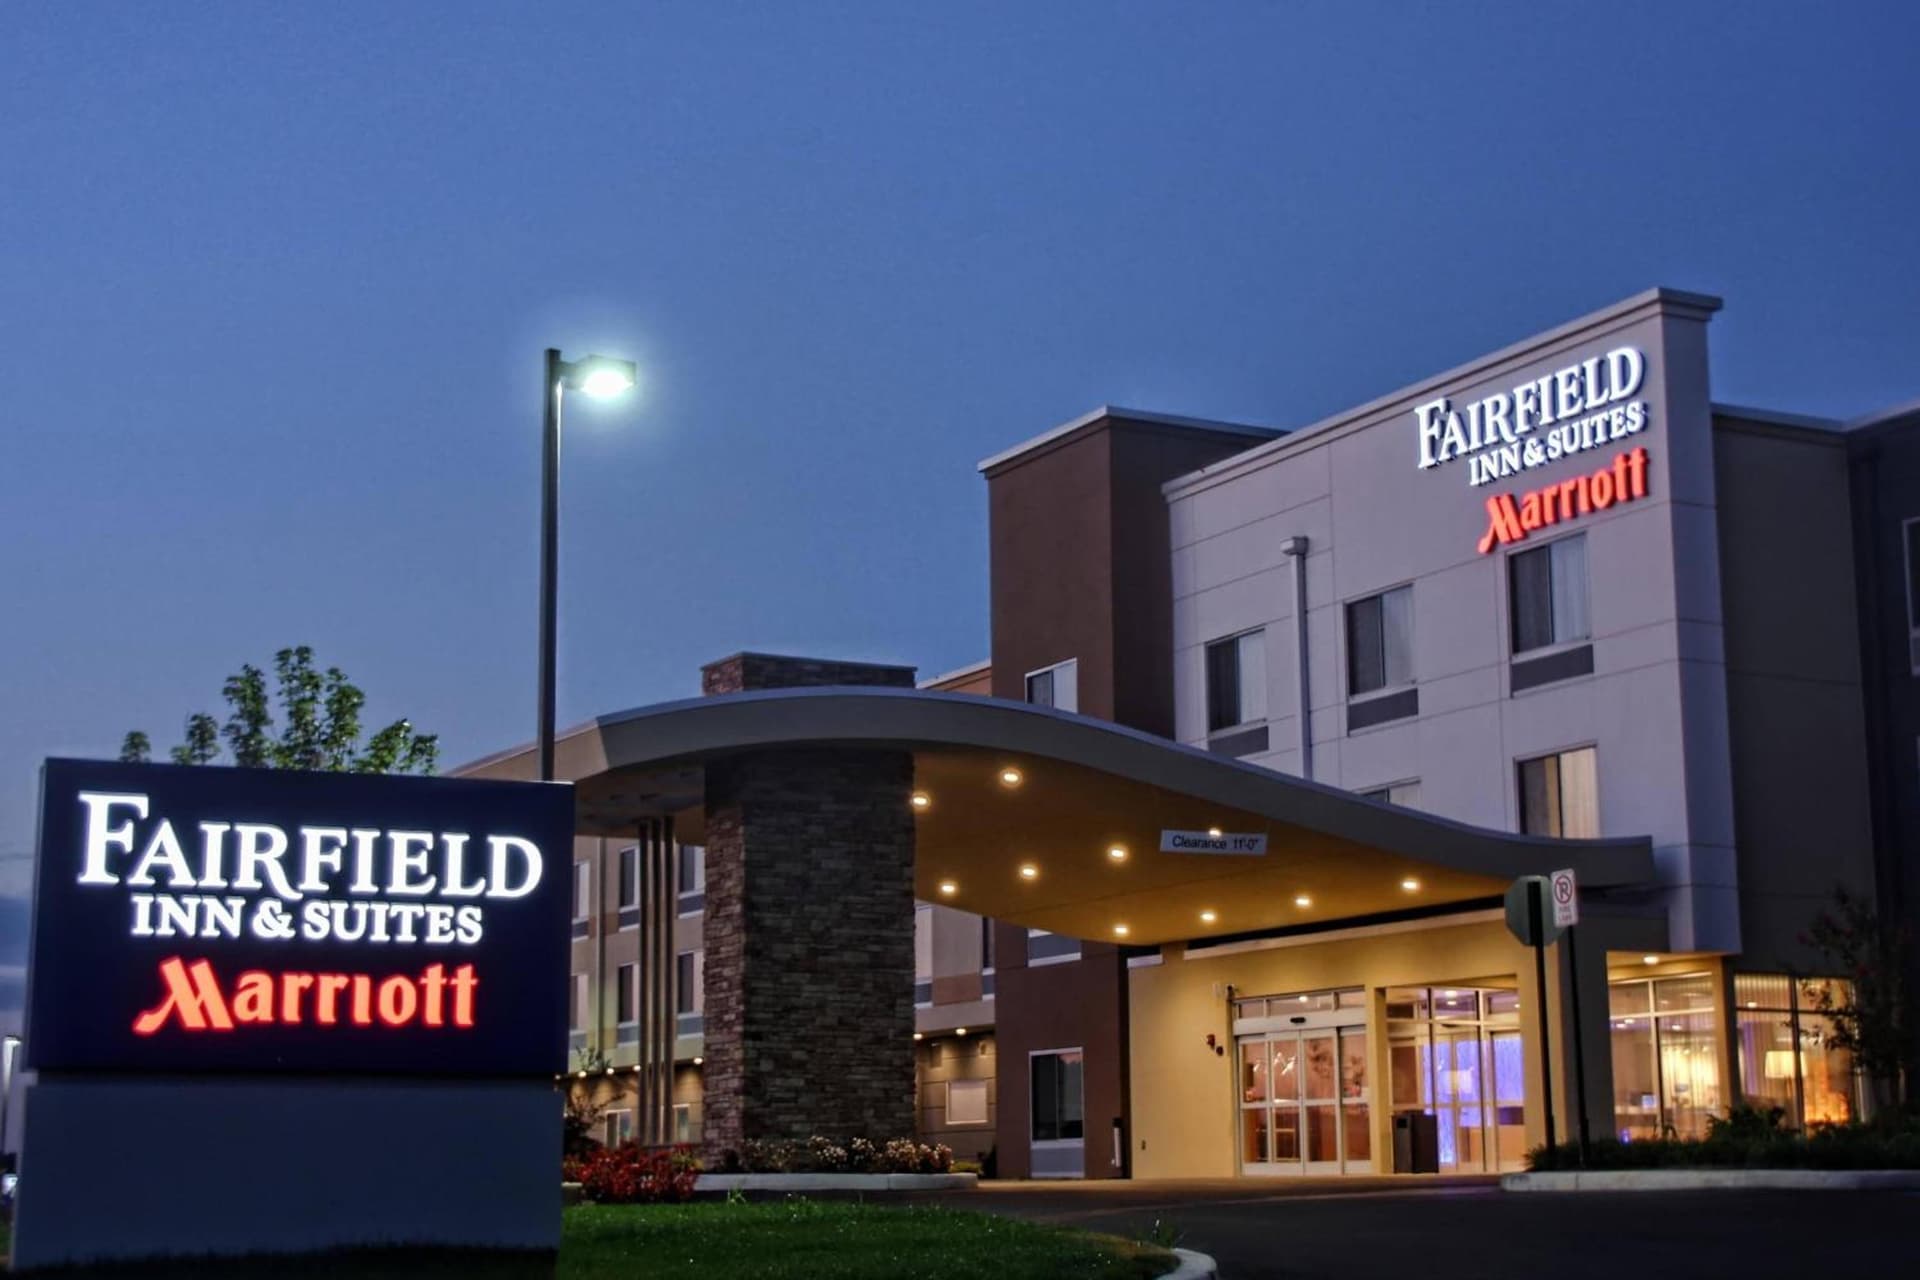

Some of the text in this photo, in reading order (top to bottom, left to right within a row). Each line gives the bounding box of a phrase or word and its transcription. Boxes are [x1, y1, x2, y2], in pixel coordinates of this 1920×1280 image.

[1414, 347, 1644, 470] FAIRFIELD
[1469, 445, 1518, 486] INN
[1547, 401, 1646, 460] SUITES
[1477, 447, 1649, 553] Marriott
[77, 791, 544, 900] FAIRFIELD
[1171, 834, 1228, 850] Clearance
[131, 894, 246, 937] INN
[303, 900, 484, 944] SUITES
[132, 956, 479, 1037] Marriott
